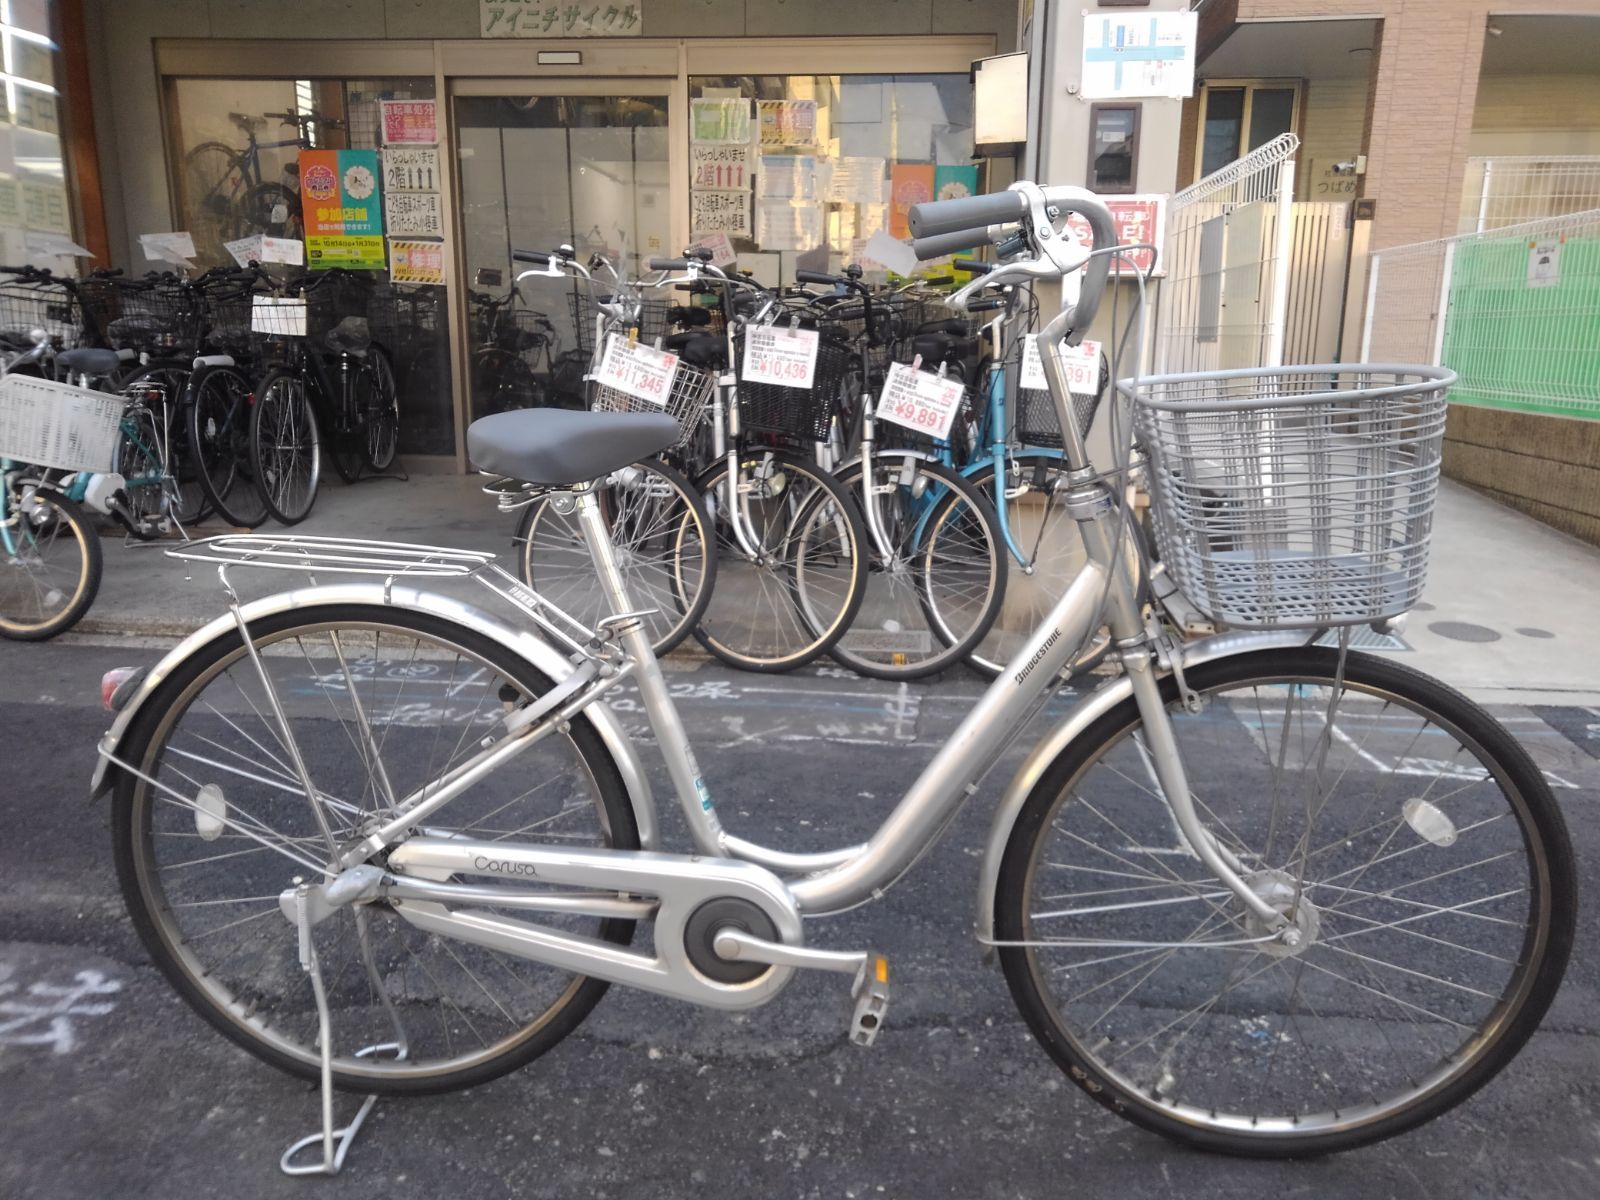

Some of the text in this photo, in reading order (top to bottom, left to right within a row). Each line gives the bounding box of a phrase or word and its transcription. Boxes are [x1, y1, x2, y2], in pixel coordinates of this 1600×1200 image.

[486, 4, 639, 33] アイニチサイクル
[384, 104, 434, 115] 自転車処分
[385, 150, 434, 164] いらっしゃいませ
[695, 149, 746, 162] いらっしゃいませ
[388, 166, 406, 189] 2階
[696, 163, 715, 187] 2階
[316, 207, 368, 222] 参加店舗
[1074, 225, 1145, 240] SE!
[616, 365, 664, 394] ¥11,345
[760, 360, 808, 380] ¥10,436
[895, 400, 946, 432] ¥9,891
[1014, 627, 1062, 686] BRIDGESTONE
[475, 856, 538, 877] Carusa
